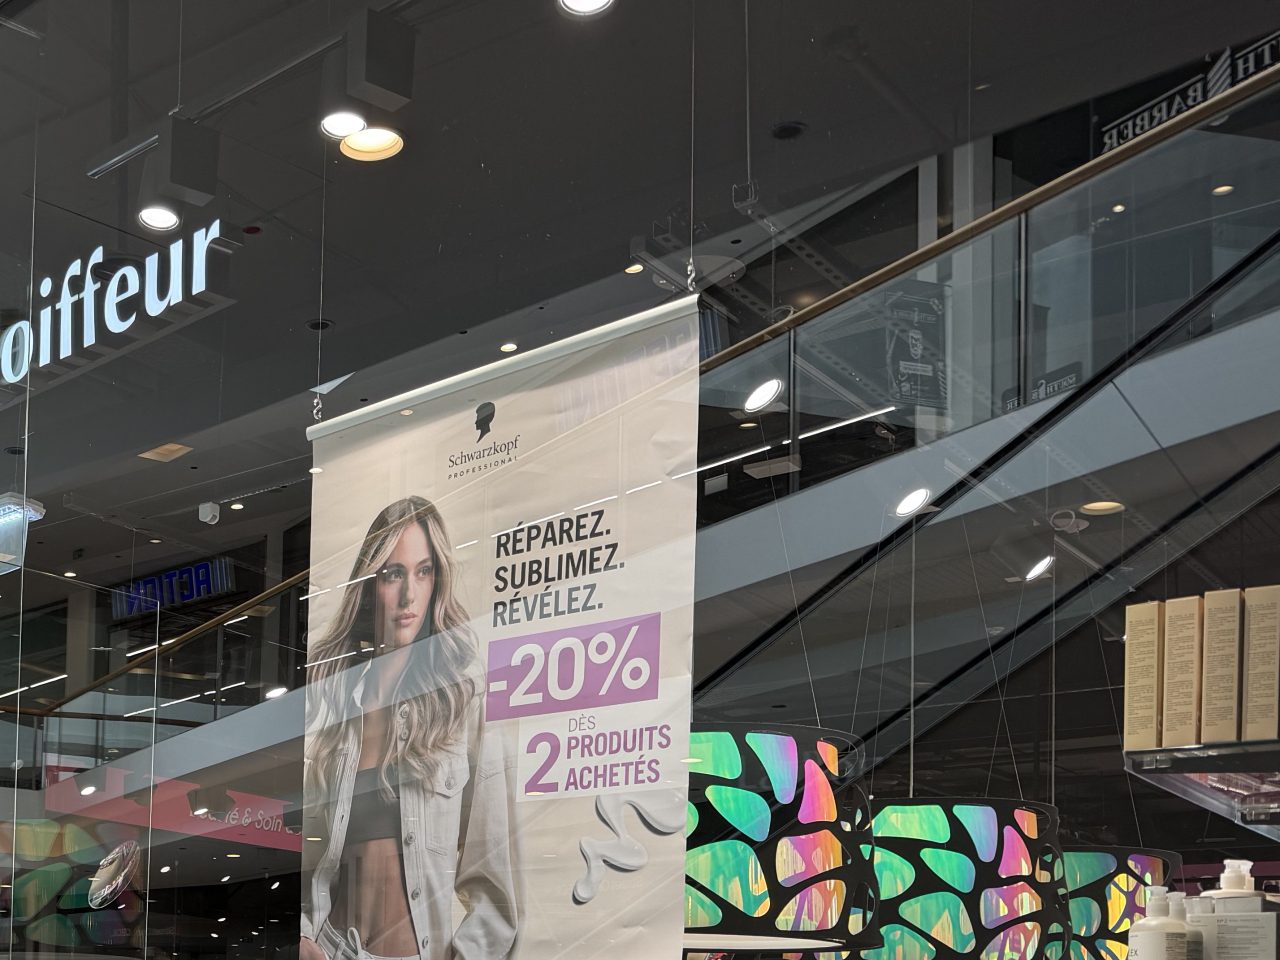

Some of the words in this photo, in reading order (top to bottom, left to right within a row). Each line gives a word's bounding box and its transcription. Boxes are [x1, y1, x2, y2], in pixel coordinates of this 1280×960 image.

[447, 455, 518, 480] PROFESSIONAL
[448, 434, 521, 468] Schwarzkopf
[496, 509, 611, 558] RÉPAREZ.
[494, 542, 625, 593] SUBLIMEZ.
[492, 583, 603, 628] RÉVÉLEZ.
[489, 625, 651, 707] -20%
[568, 713, 596, 732] DÈS
[525, 731, 561, 795] 2
[566, 724, 671, 759] PRODUITS
[565, 754, 661, 792] ACHETÉS
